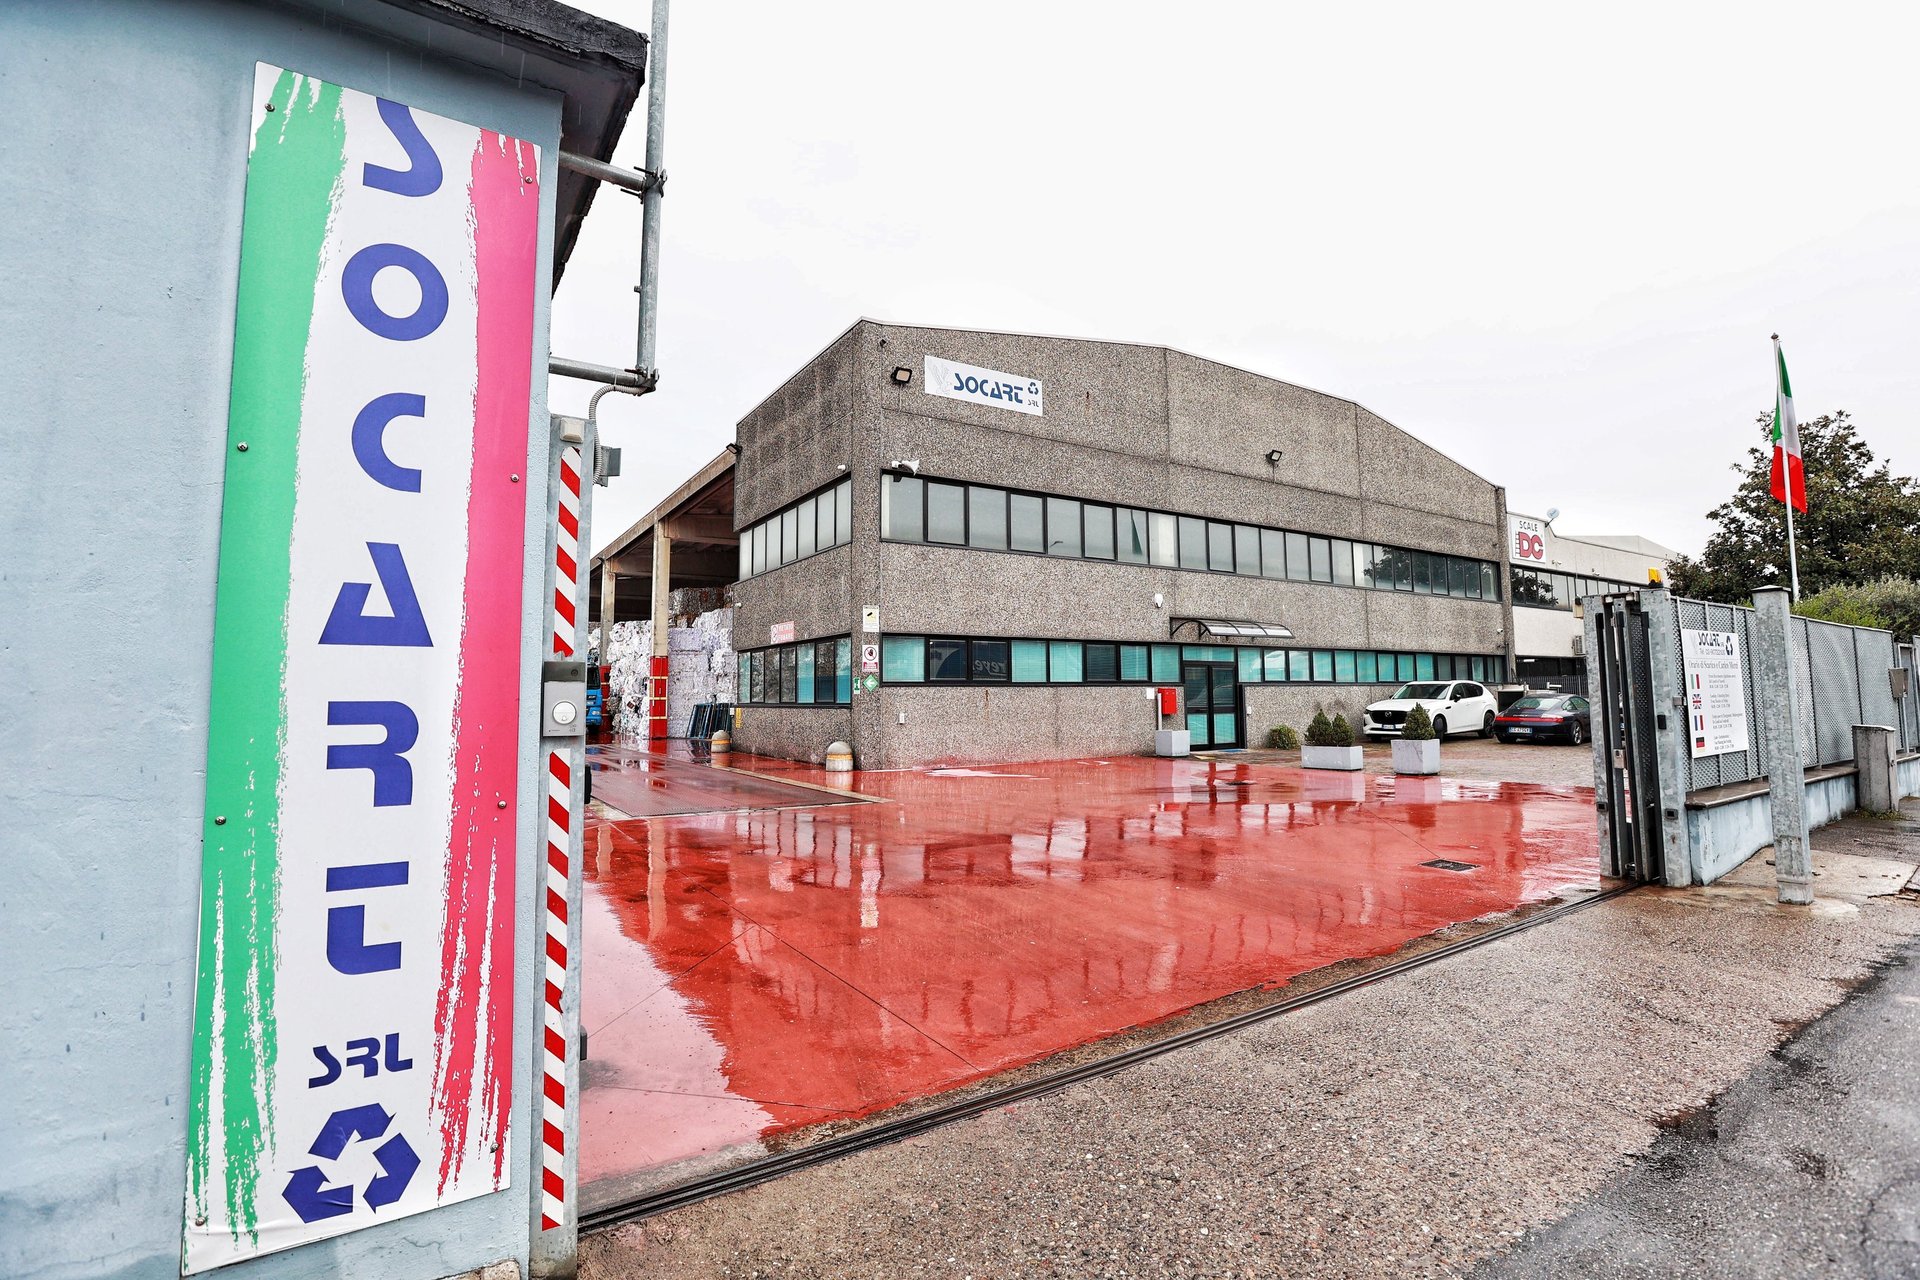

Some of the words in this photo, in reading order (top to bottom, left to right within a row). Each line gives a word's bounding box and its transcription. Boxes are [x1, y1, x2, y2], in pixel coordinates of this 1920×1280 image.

[953, 372, 1024, 404] SOCART
[1027, 398, 1040, 408] SRL
[319, 97, 449, 976] SOCART
[1520, 521, 1538, 532] SCALE
[1519, 532, 1543, 560] DC
[1698, 632, 1720, 646] SOCART
[308, 1033, 413, 1089] SRL
